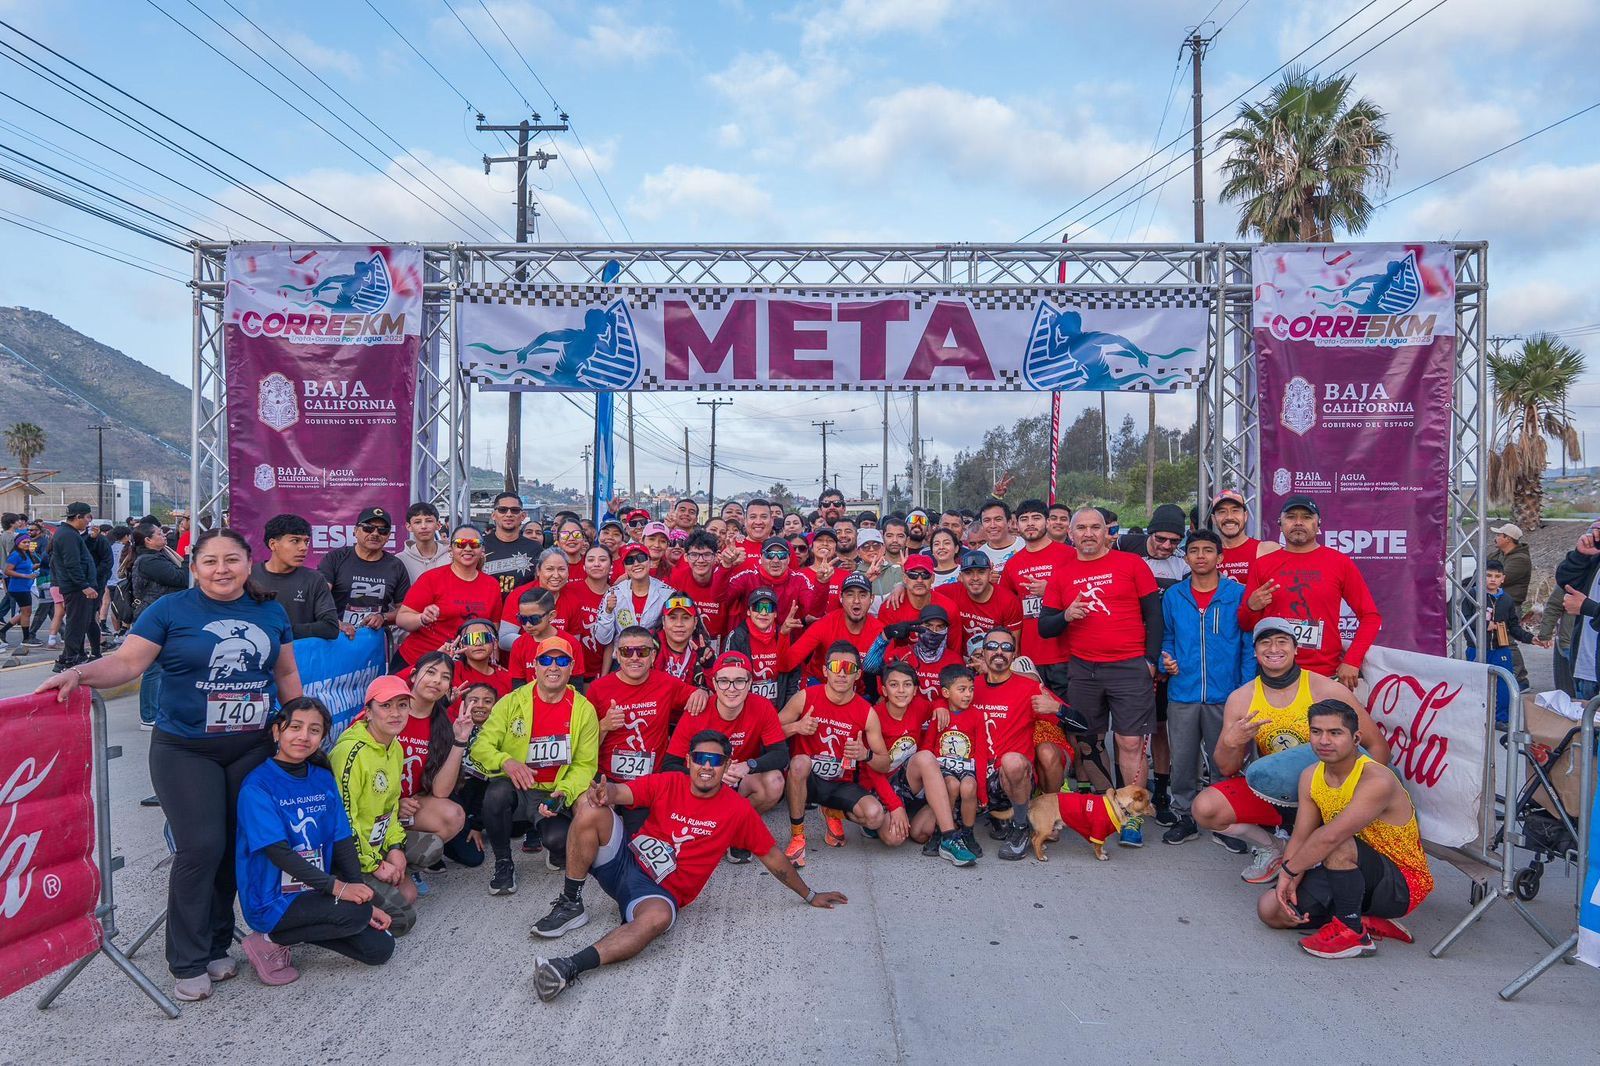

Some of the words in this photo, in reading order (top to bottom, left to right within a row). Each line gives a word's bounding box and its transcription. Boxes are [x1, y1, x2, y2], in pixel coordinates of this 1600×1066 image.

[1272, 314, 1437, 339] CORRE5KM
[663, 299, 996, 381] META
[303, 380, 370, 399] BAJA
[1324, 383, 1389, 401] BAJA
[304, 400, 396, 410] CALIFORNIA
[1322, 402, 1415, 413] CALIFORNIA
[277, 467, 307, 477] BAJA
[1295, 472, 1321, 481] BAJA
[352, 575, 386, 584] HERBALIFE
[1094, 579, 1113, 587] TECATE
[1293, 625, 1312, 643] 94
[195, 680, 268, 690] GLADIADORES
[631, 701, 657, 709] RUNNERS
[214, 702, 256, 724] 140
[829, 719, 853, 730] RUNNERS
[396, 735, 409, 743] AJA
[415, 747, 429, 755] TEC
[531, 742, 560, 761] 110
[616, 756, 646, 774] 234
[812, 761, 840, 776] 093
[280, 799, 296, 807] BAJA
[297, 794, 326, 805] RUNNERS
[670, 812, 686, 823] BAJA
[687, 818, 717, 828] RUNNERS
[691, 827, 713, 836] TECATE
[638, 838, 670, 870] 092
